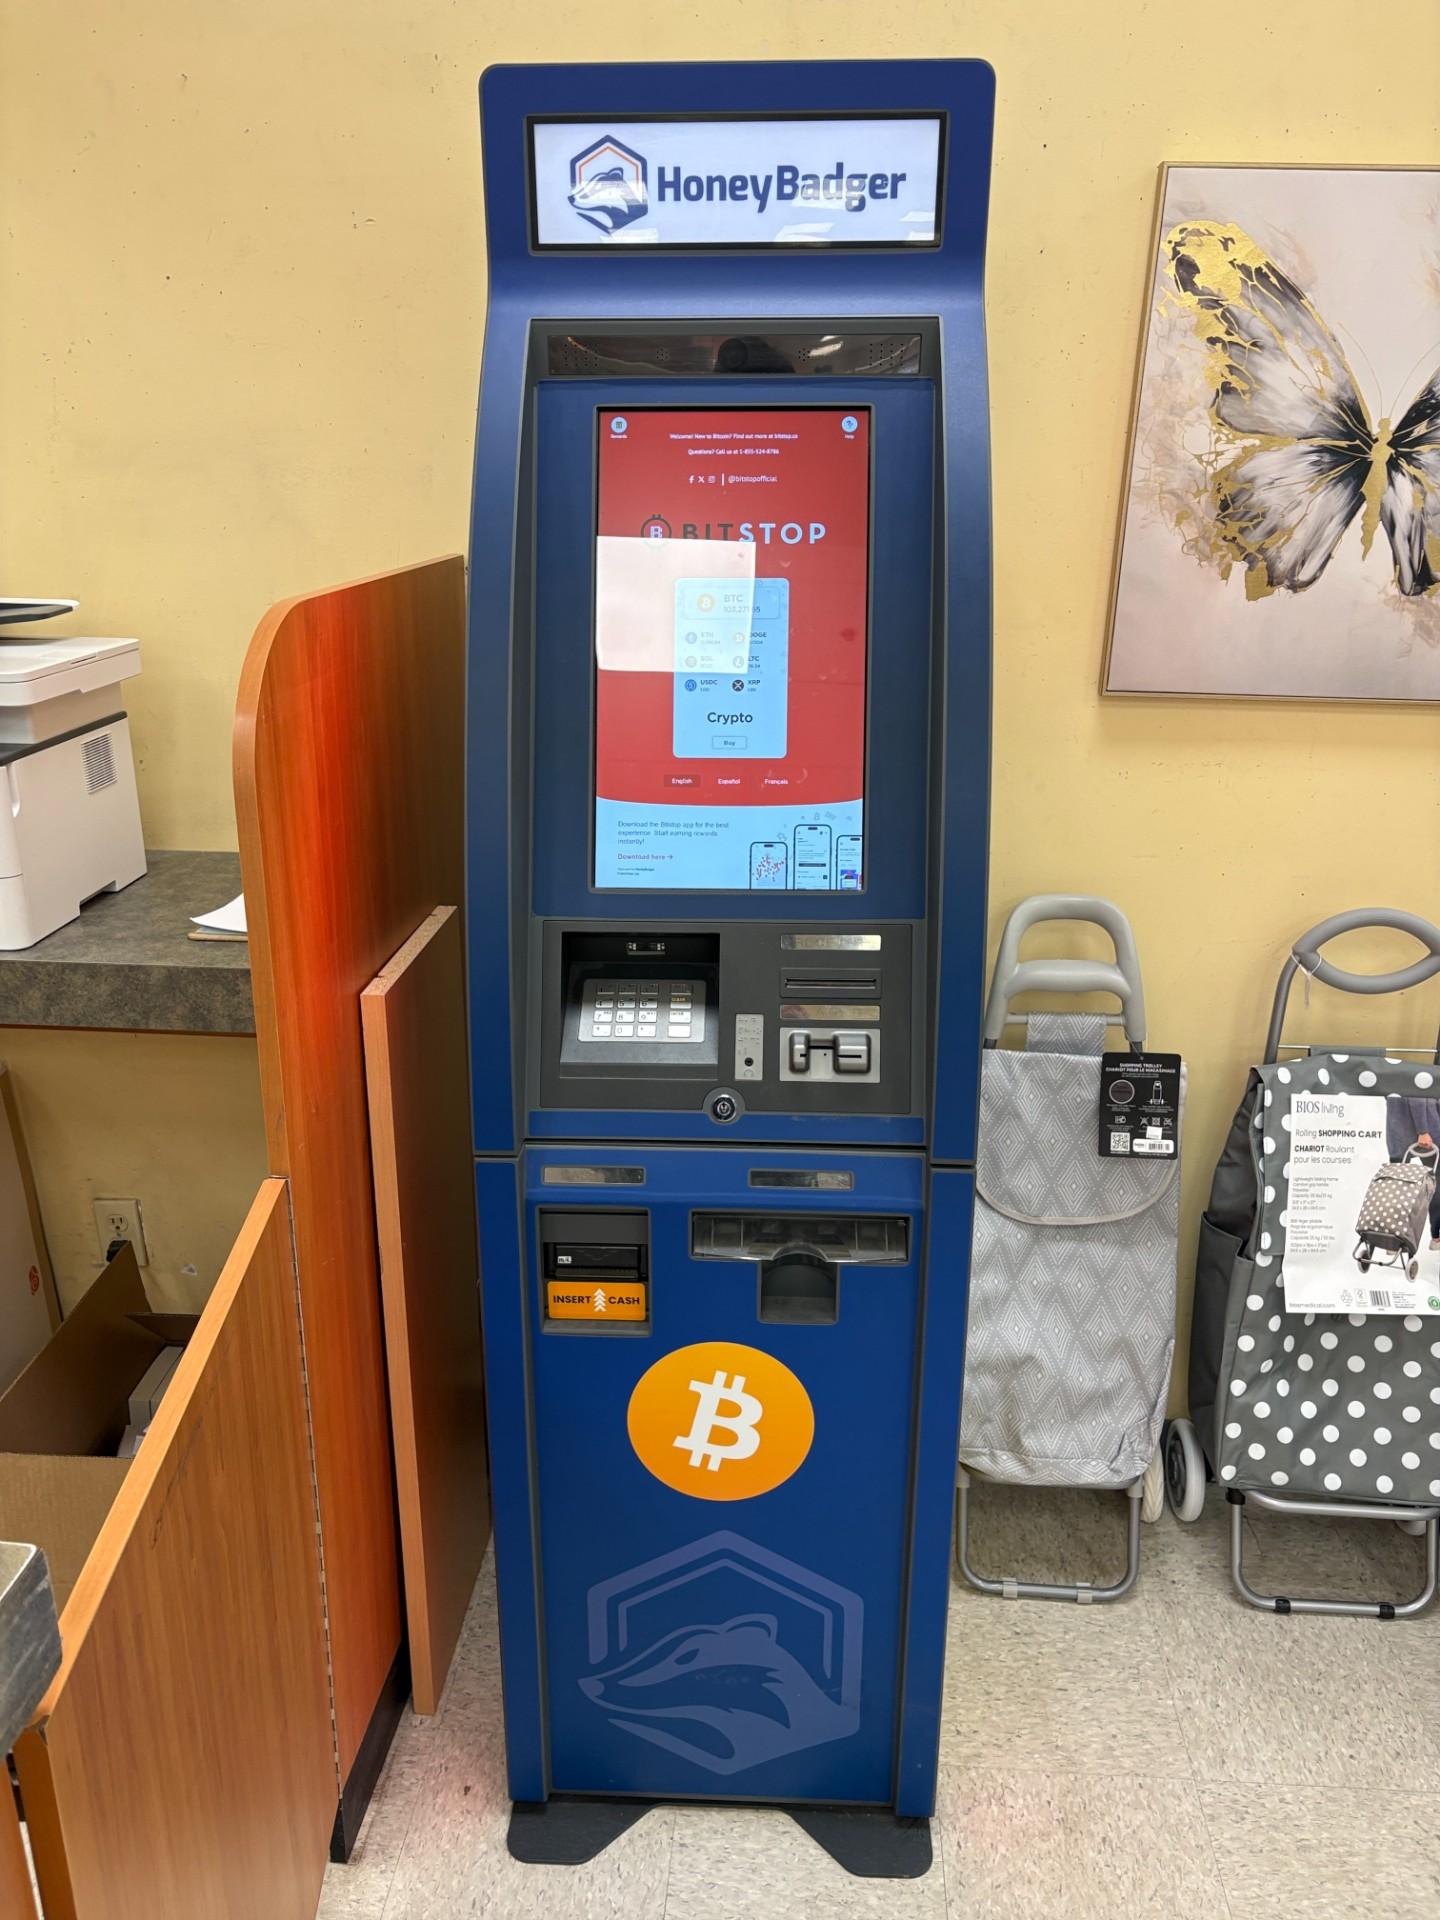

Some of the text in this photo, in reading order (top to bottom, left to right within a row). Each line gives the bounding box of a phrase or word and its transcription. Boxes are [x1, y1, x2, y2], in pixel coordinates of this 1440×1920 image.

[657, 162, 906, 213] HoneyBadger
[728, 475, 778, 484] @bitstopofficial
[683, 523, 826, 545] BITSTOP
[723, 594, 743, 603] BTC
[707, 712, 753, 725] Crypto
[718, 777, 741, 785] Español
[764, 777, 788, 786] Français
[1296, 1101, 1345, 1117] BIOS living
[1295, 1129, 1383, 1139] Rolling SHOPPING CART
[1294, 1145, 1355, 1154] CHARIOT Roulant
[1293, 1157, 1309, 1165] pour
[1311, 1156, 1321, 1164] les
[553, 1295, 641, 1305] INSERT CASH
